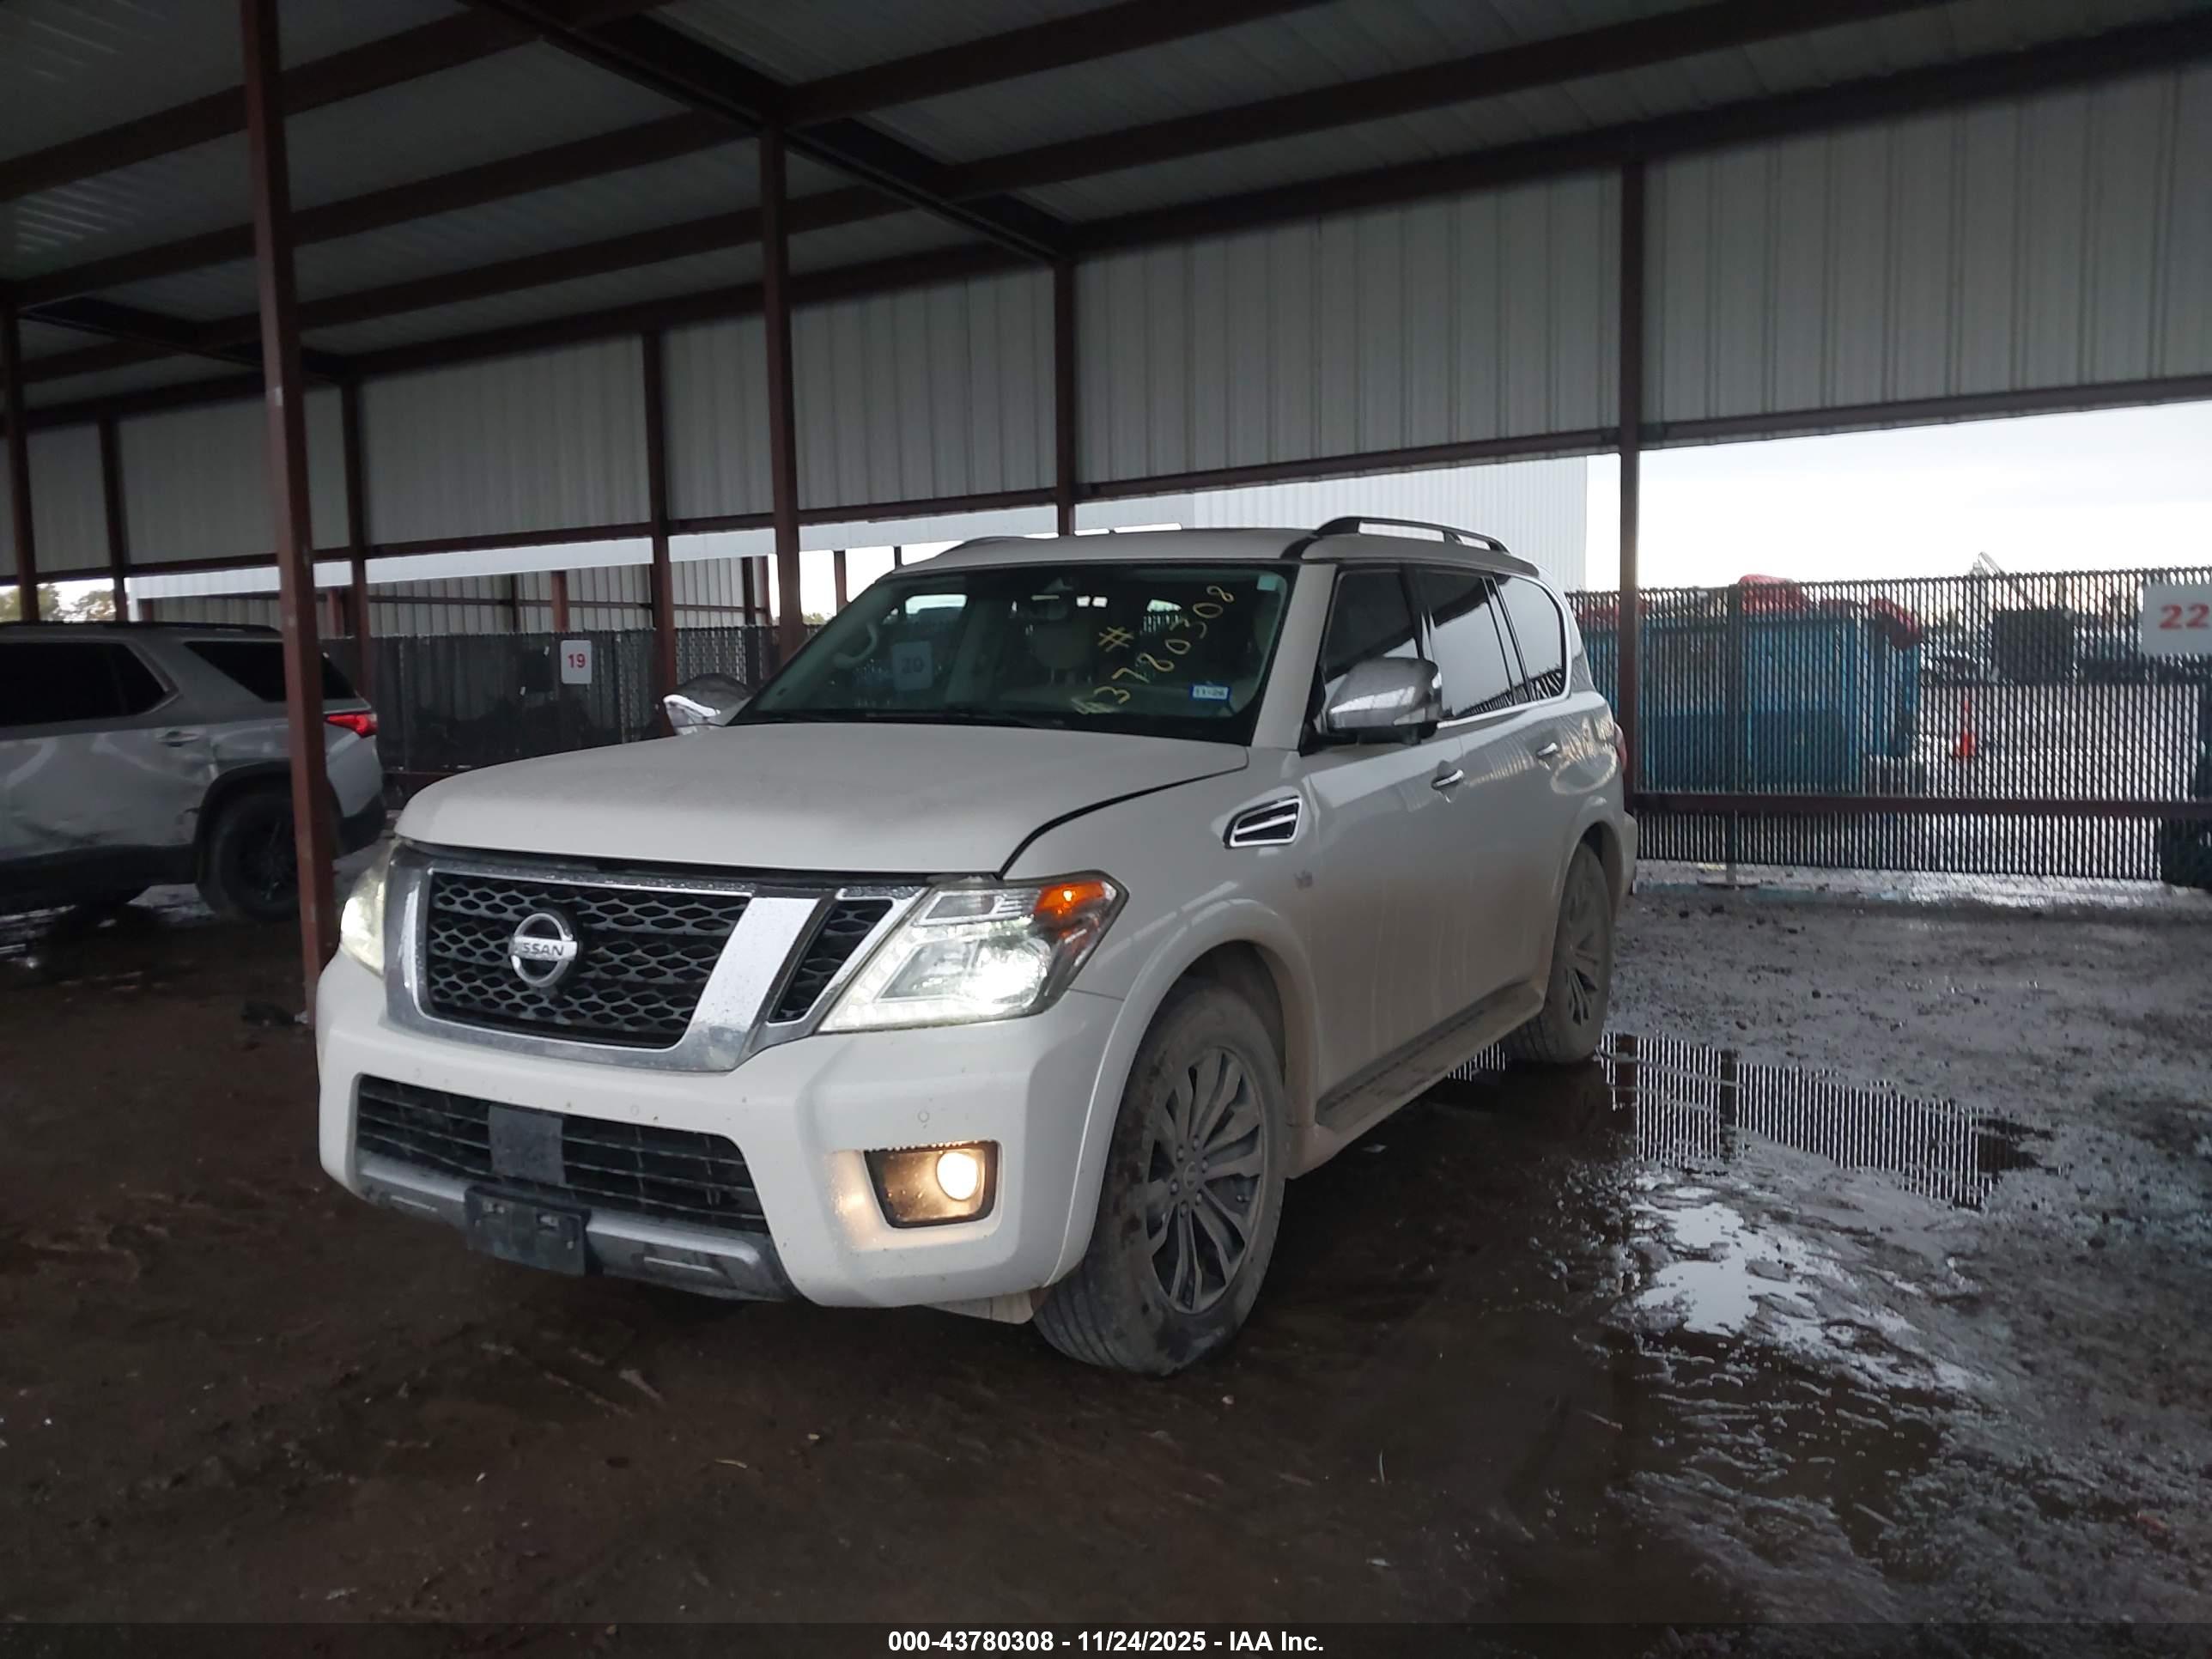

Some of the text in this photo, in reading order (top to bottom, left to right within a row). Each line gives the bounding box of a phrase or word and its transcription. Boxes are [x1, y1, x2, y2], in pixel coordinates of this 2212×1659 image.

[2159, 604, 2209, 629] 22
[568, 653, 586, 668] 19
[514, 942, 564, 956] SSAN
